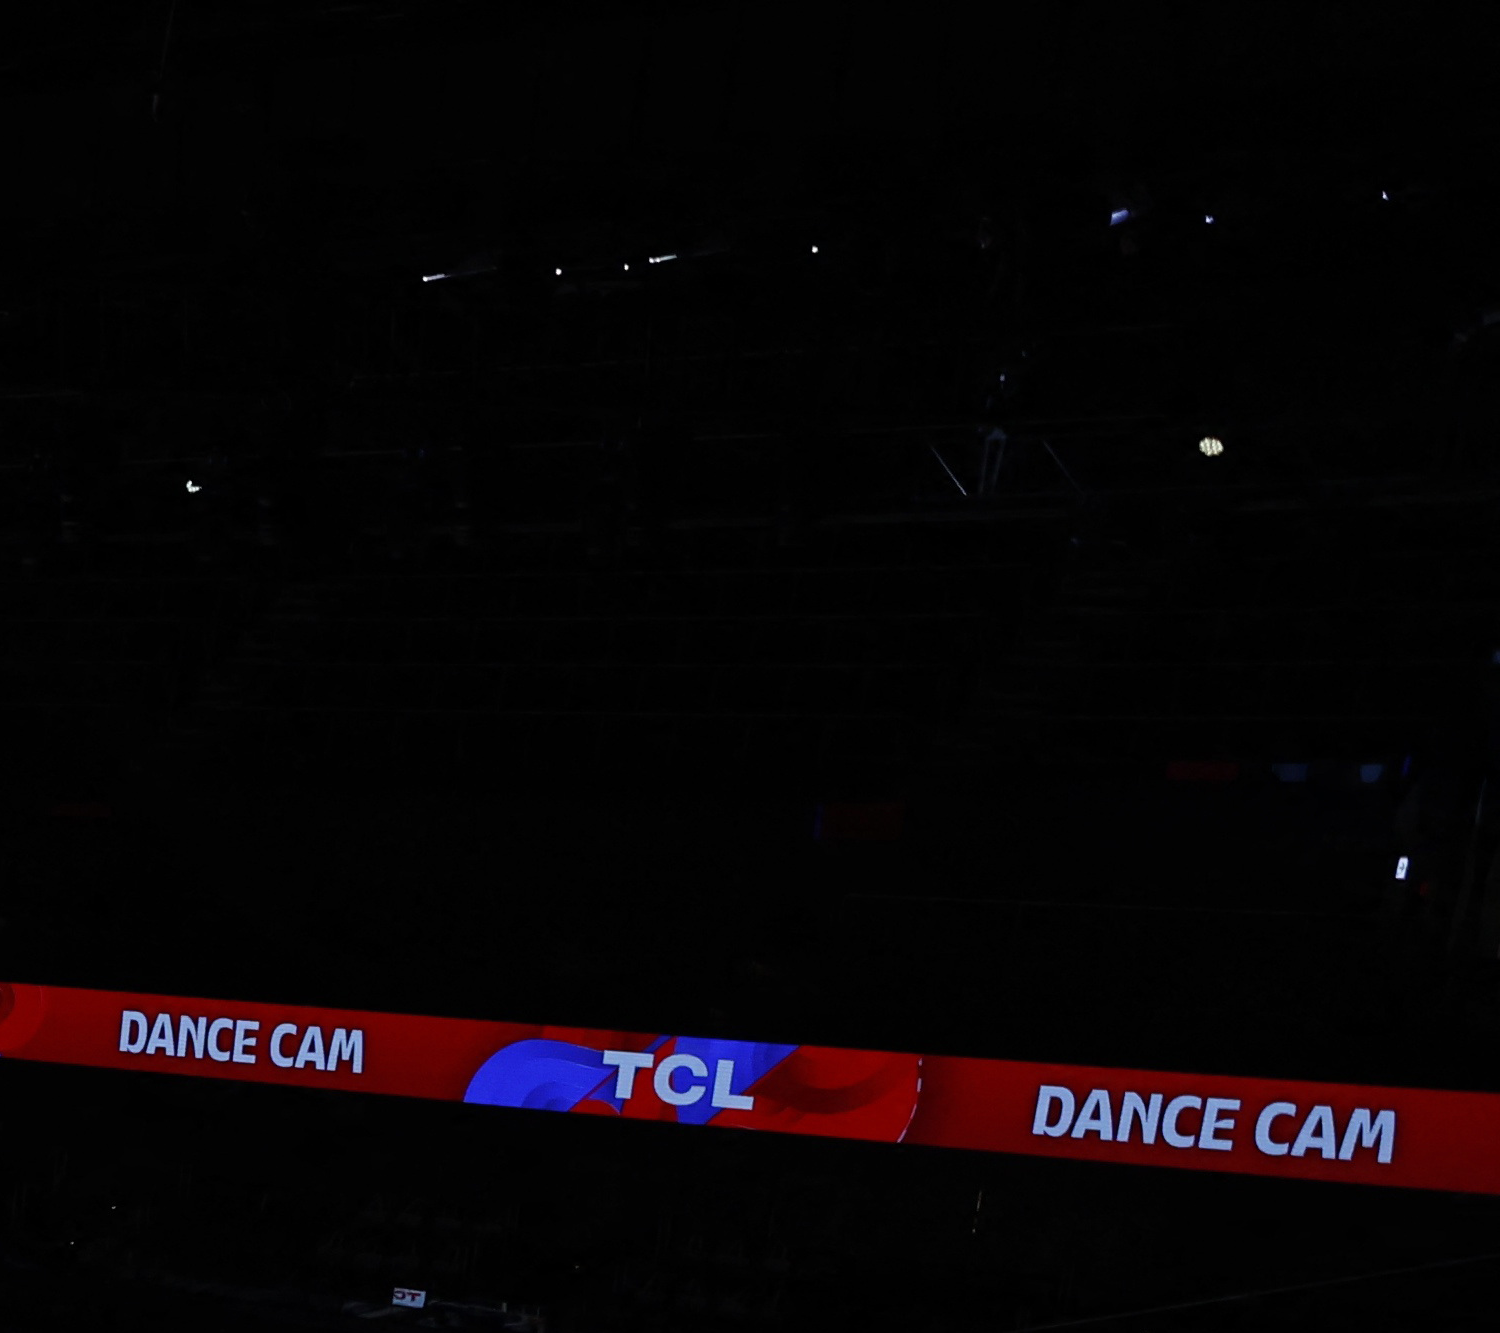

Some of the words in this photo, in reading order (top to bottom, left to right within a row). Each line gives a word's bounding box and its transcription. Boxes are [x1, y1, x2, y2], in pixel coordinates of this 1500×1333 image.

[120, 1011, 259, 1063] DANCE
[271, 1024, 362, 1073] CAM
[603, 1050, 754, 1110] TCL
[1033, 1085, 1237, 1150] DANCE
[1255, 1102, 1395, 1163] CAM
